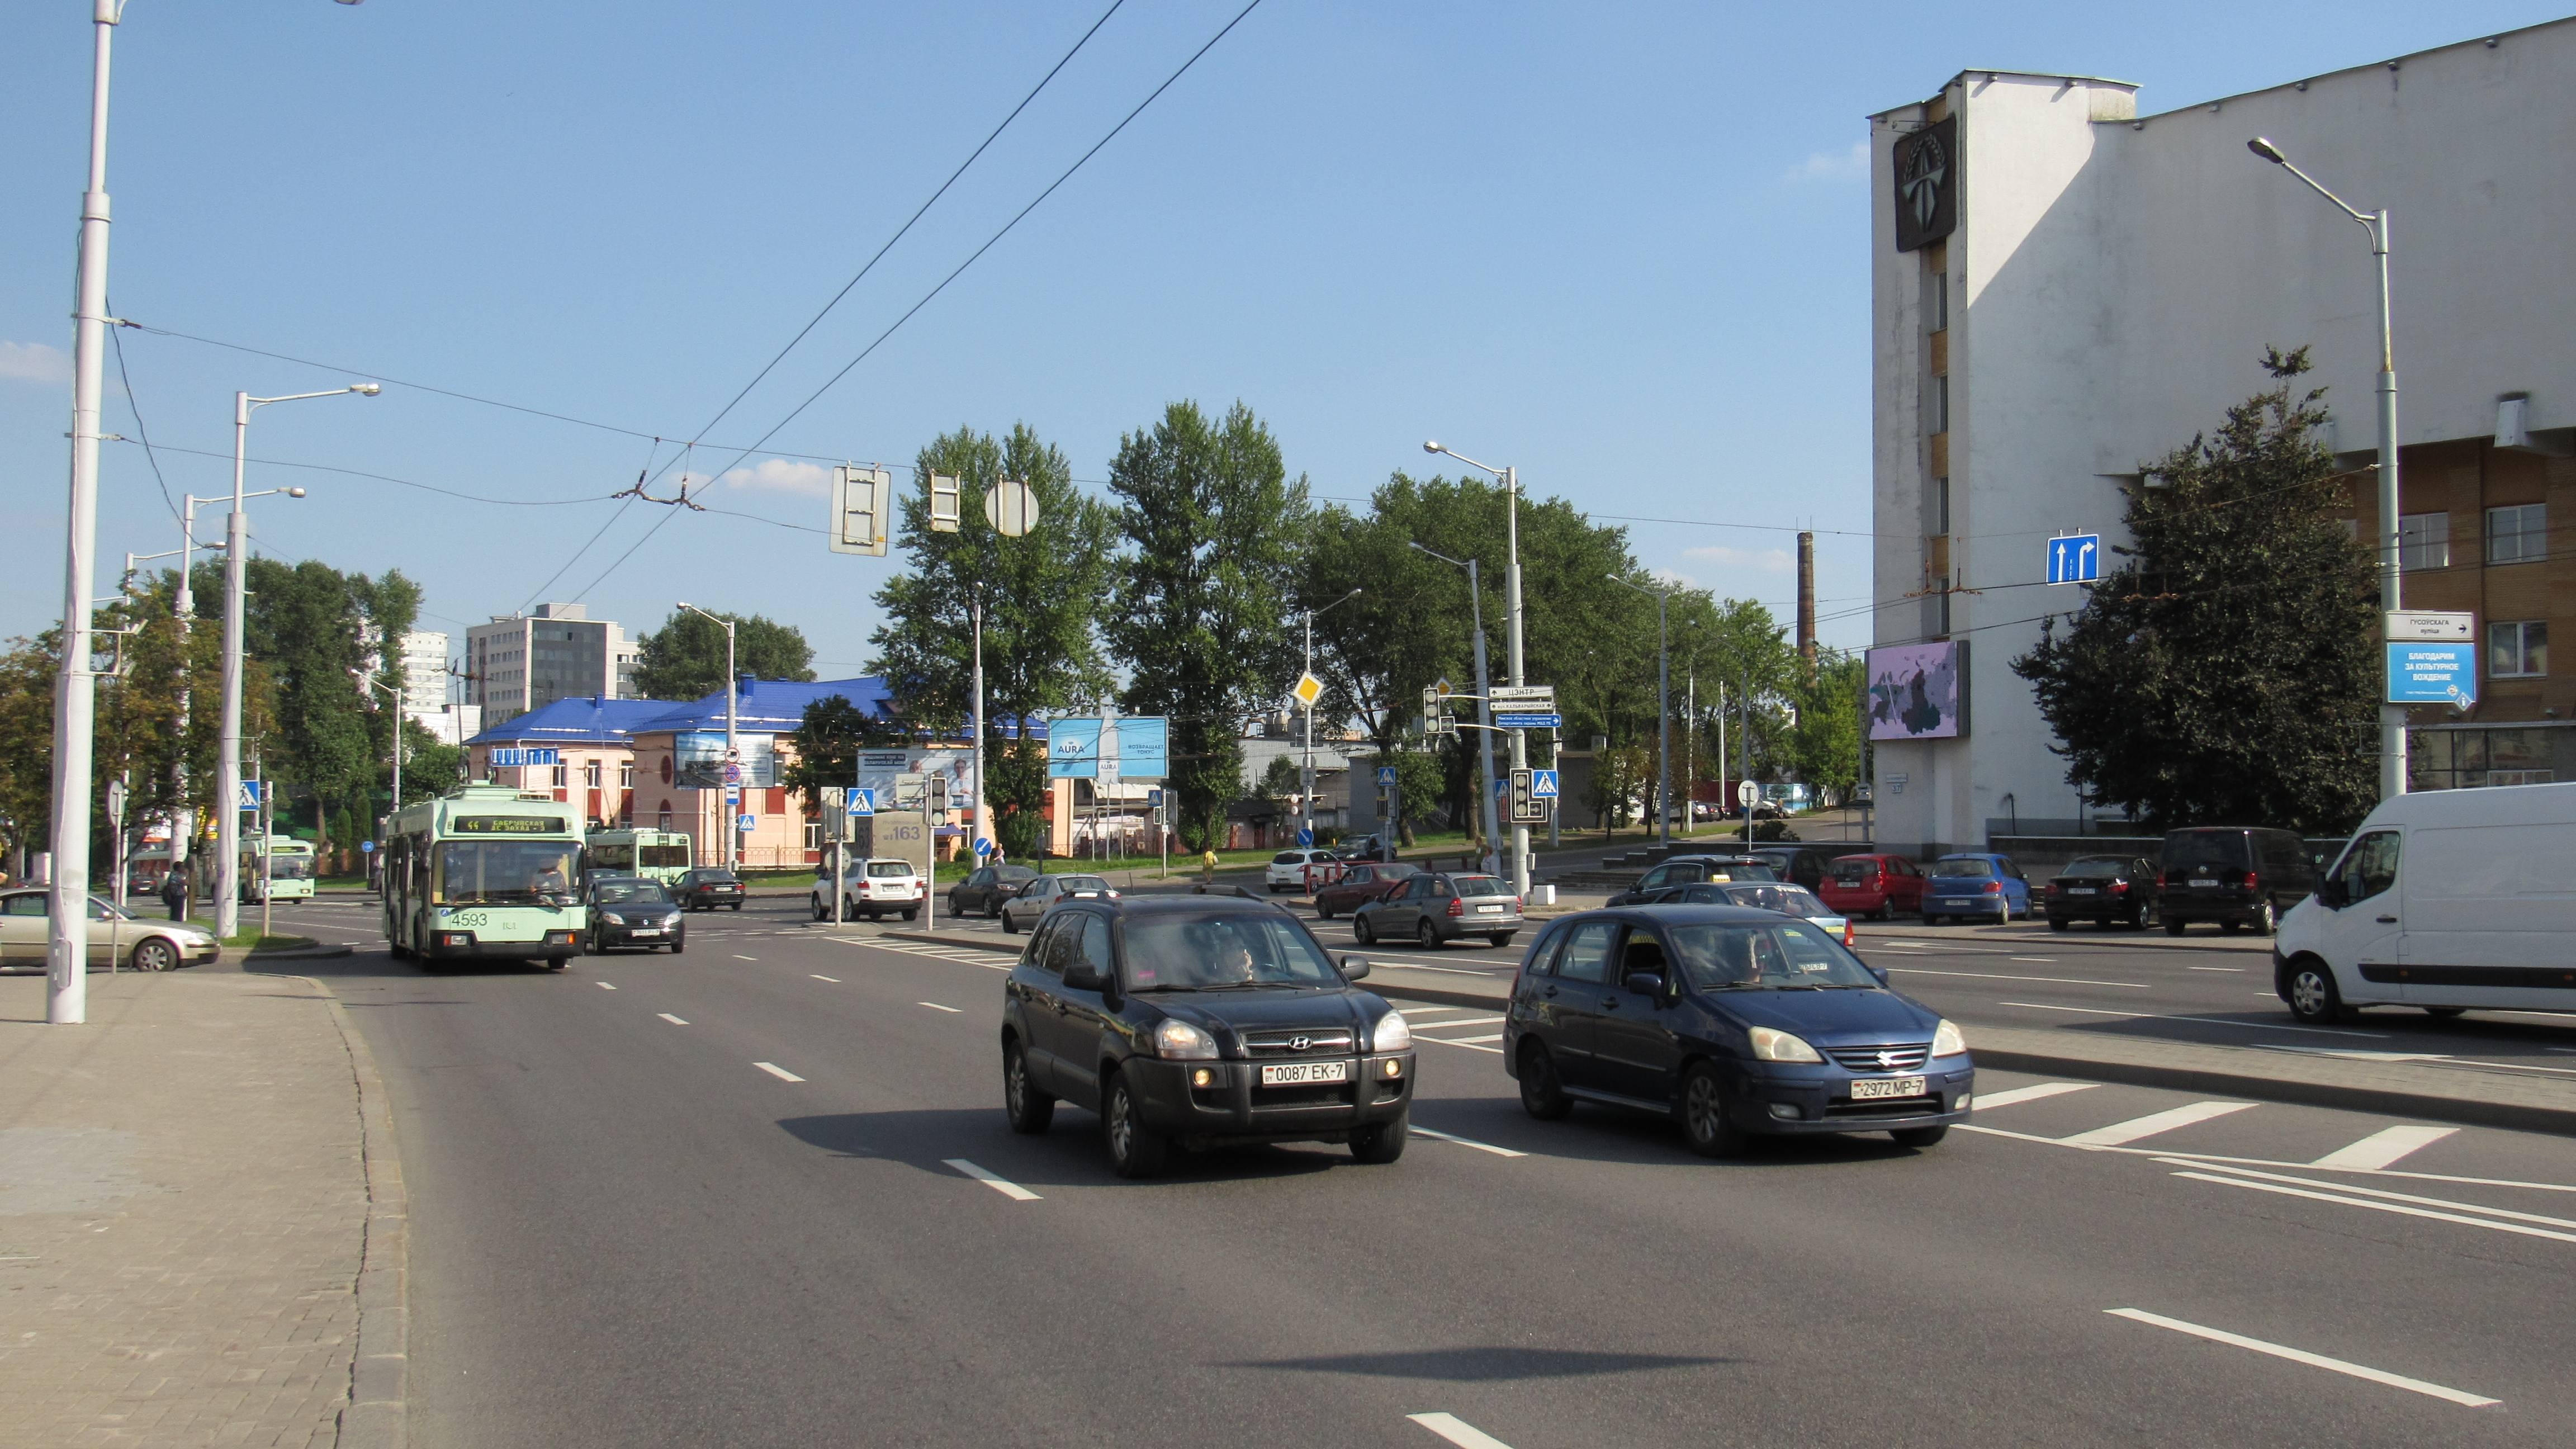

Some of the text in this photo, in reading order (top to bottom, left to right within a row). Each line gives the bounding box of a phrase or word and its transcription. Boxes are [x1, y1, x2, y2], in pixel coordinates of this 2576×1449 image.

[2408, 652, 2455, 661] БЛАГОДАРИМ
[893, 826, 920, 840] 163
[452, 913, 487, 926] 4593
[1276, 1065, 1307, 1081] 0087
[1311, 1064, 1343, 1079] EK-7
[1863, 1082, 1891, 1096] 2972
[1893, 1079, 1923, 1094] MP-7
